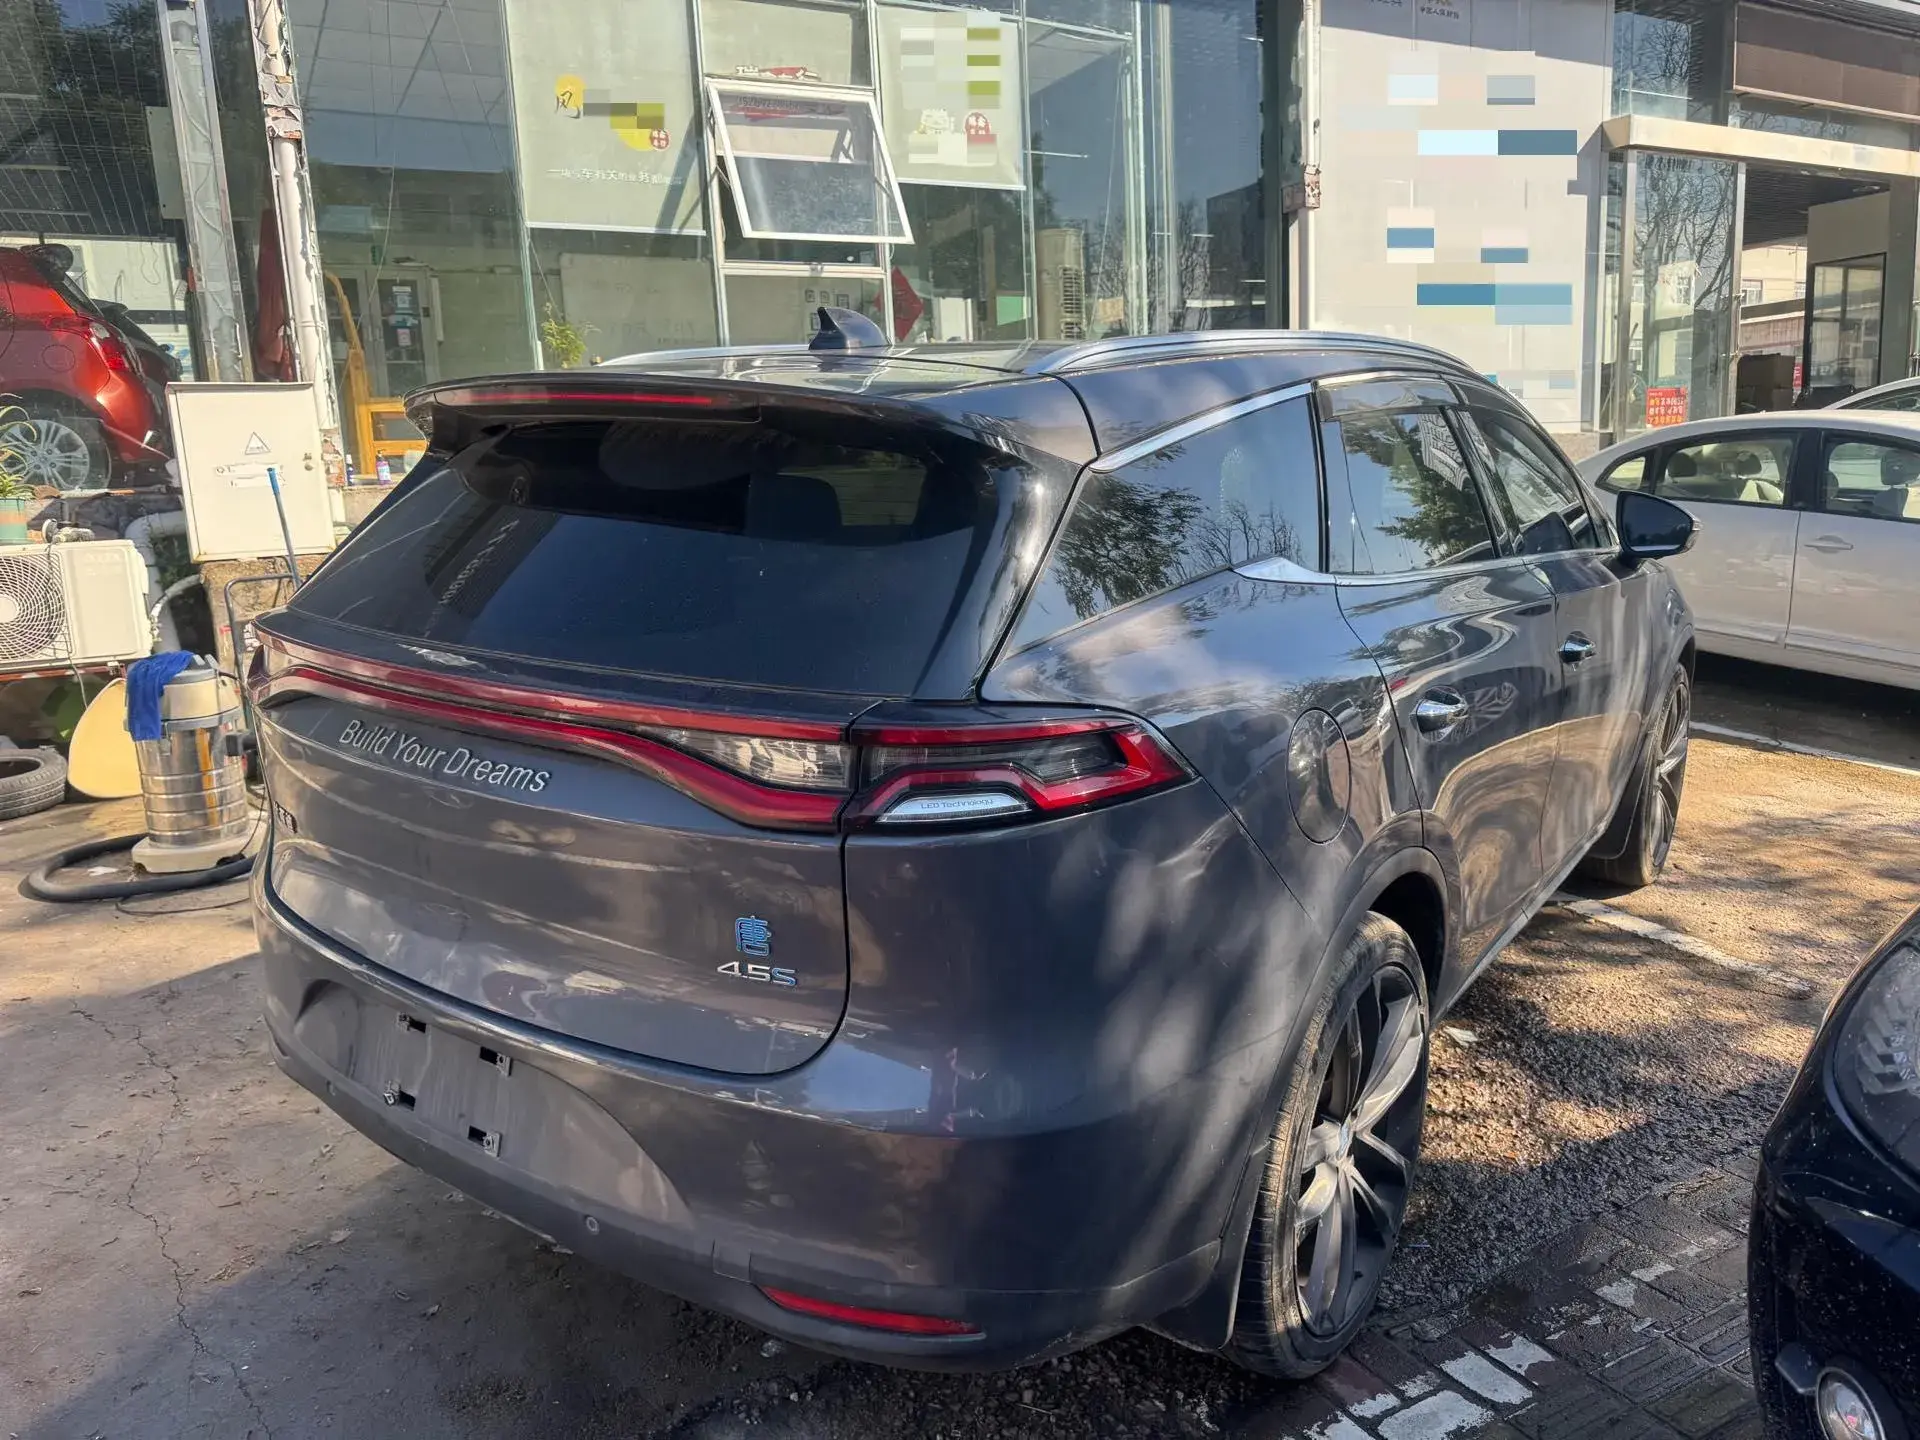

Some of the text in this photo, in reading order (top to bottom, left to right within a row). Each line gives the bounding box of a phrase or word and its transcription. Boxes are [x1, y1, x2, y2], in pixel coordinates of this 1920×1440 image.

[339, 719, 550, 792] Build Your Dreams
[942, 799, 994, 808] Technology
